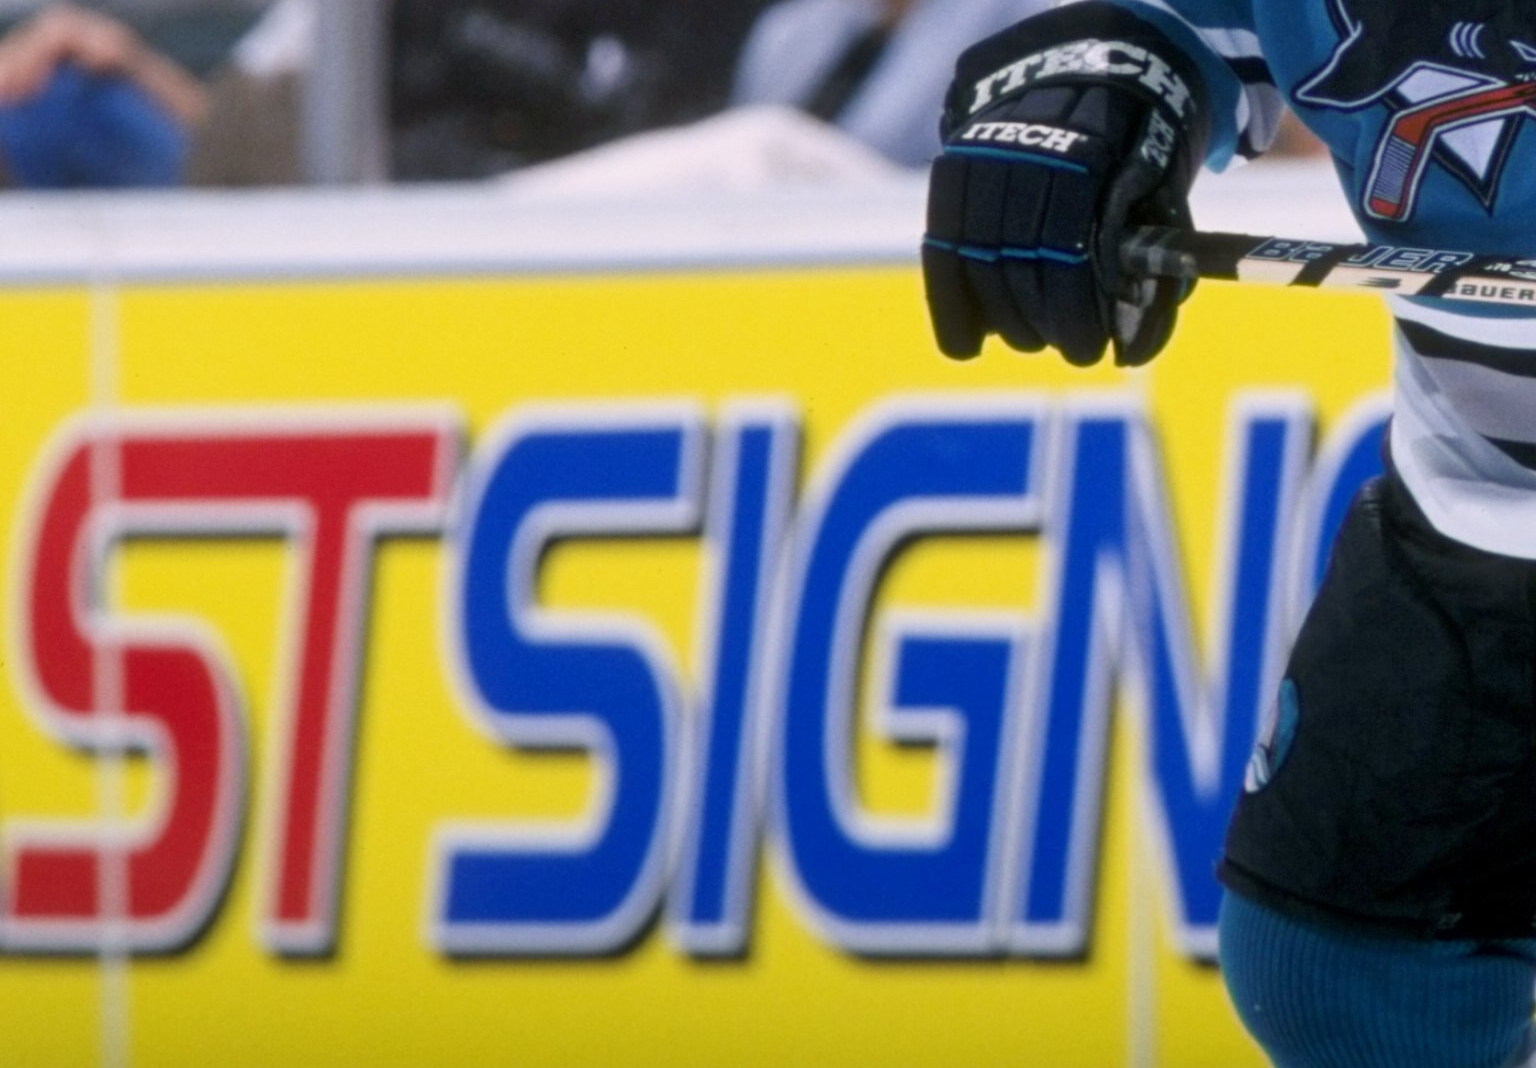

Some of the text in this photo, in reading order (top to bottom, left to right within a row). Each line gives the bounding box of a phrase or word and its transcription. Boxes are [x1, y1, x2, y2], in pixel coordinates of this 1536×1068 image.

[968, 37, 1196, 119] ITECH
[961, 121, 1079, 153] ITECH
[0, 388, 1394, 962] STSIGN
